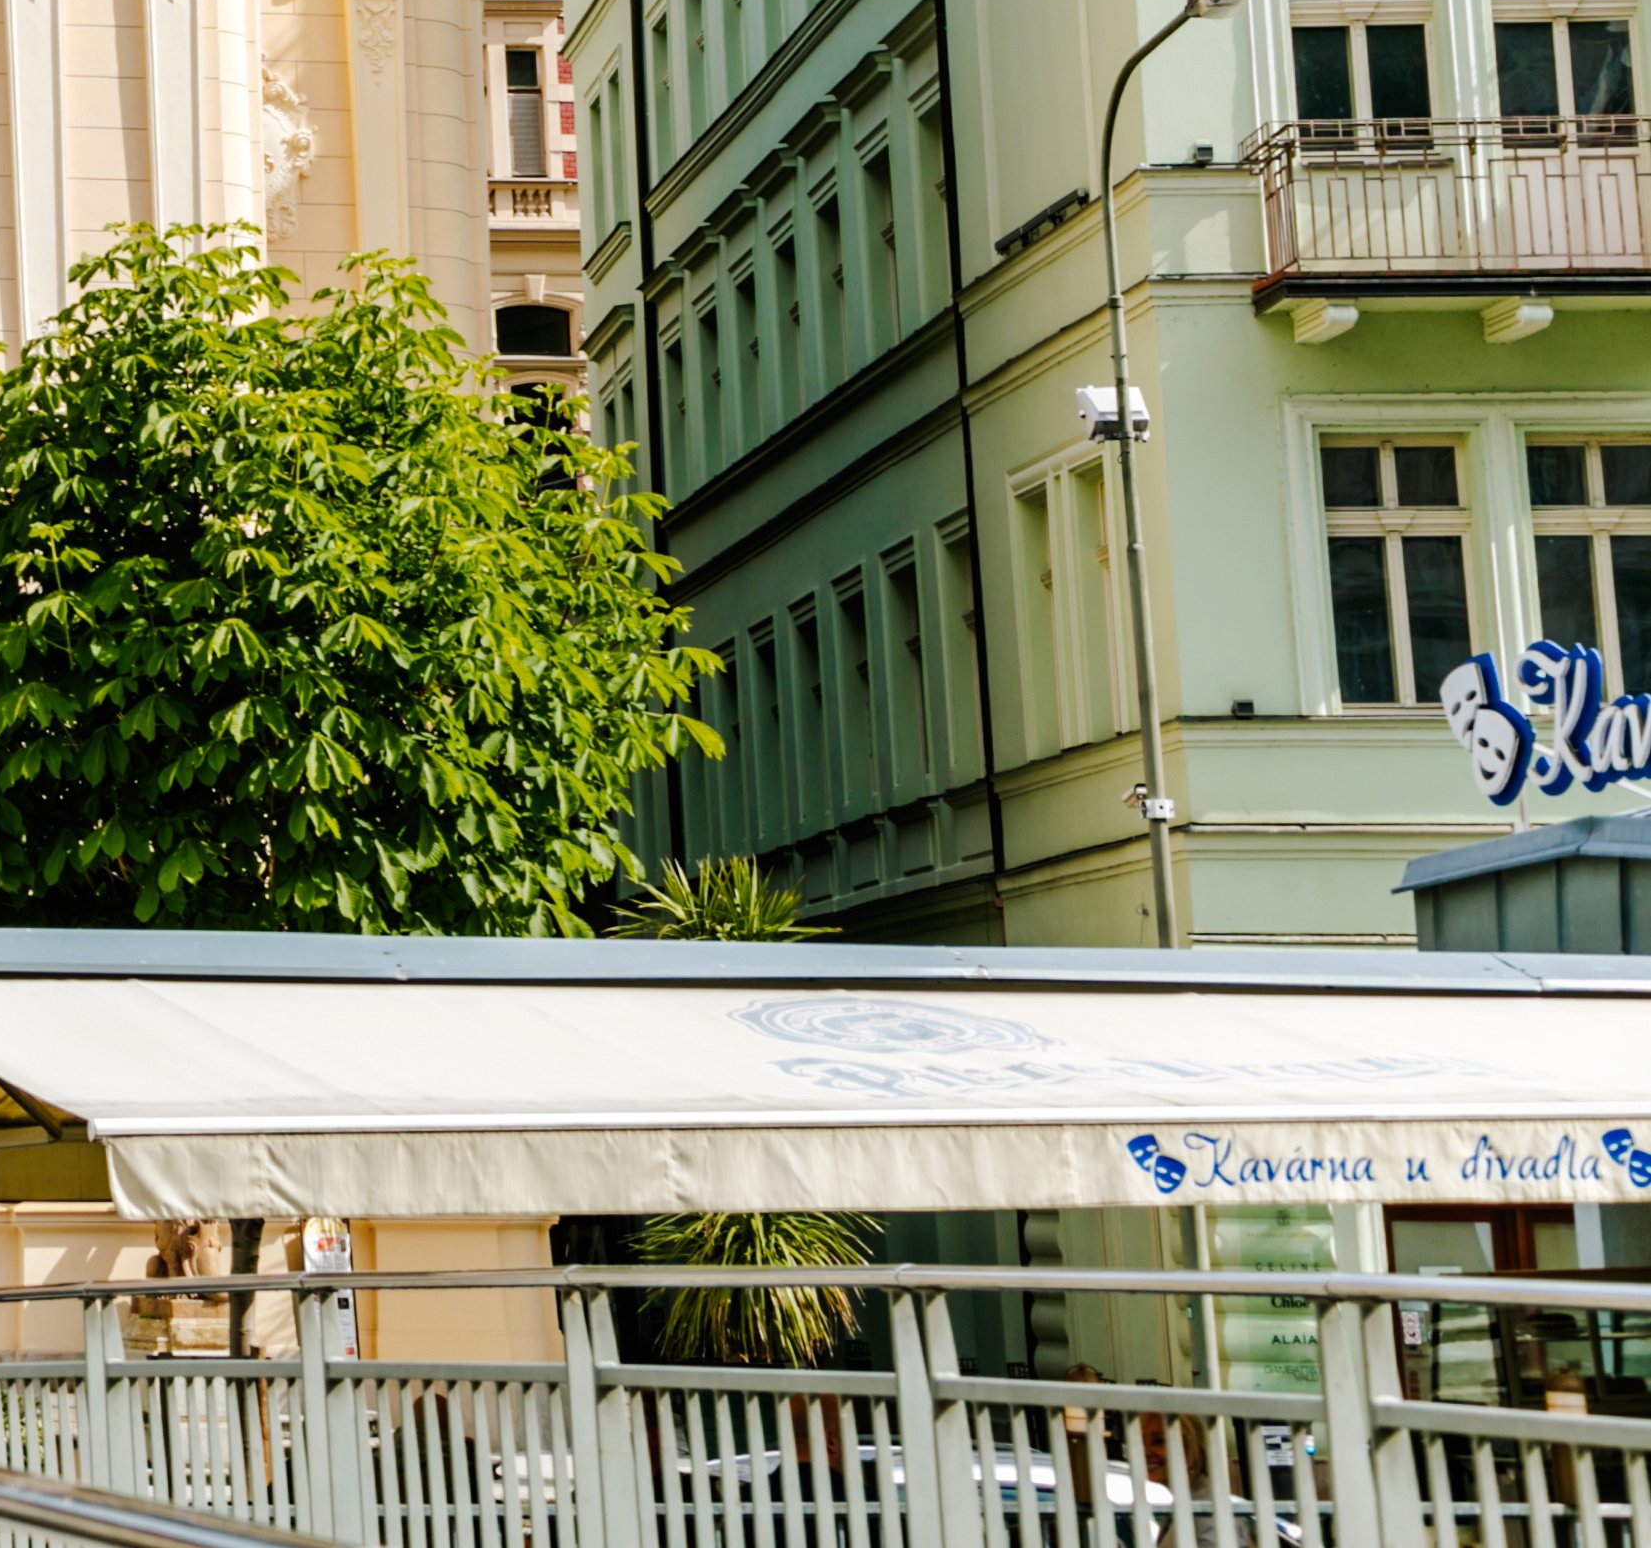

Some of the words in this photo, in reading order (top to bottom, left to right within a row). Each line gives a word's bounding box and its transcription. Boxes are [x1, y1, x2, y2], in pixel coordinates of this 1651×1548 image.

[1183, 1132, 1376, 1188] Kavárna
[1406, 1155, 1430, 1182] u
[1461, 1134, 1601, 1182] divadla
[1254, 1262, 1321, 1272] CELINE
